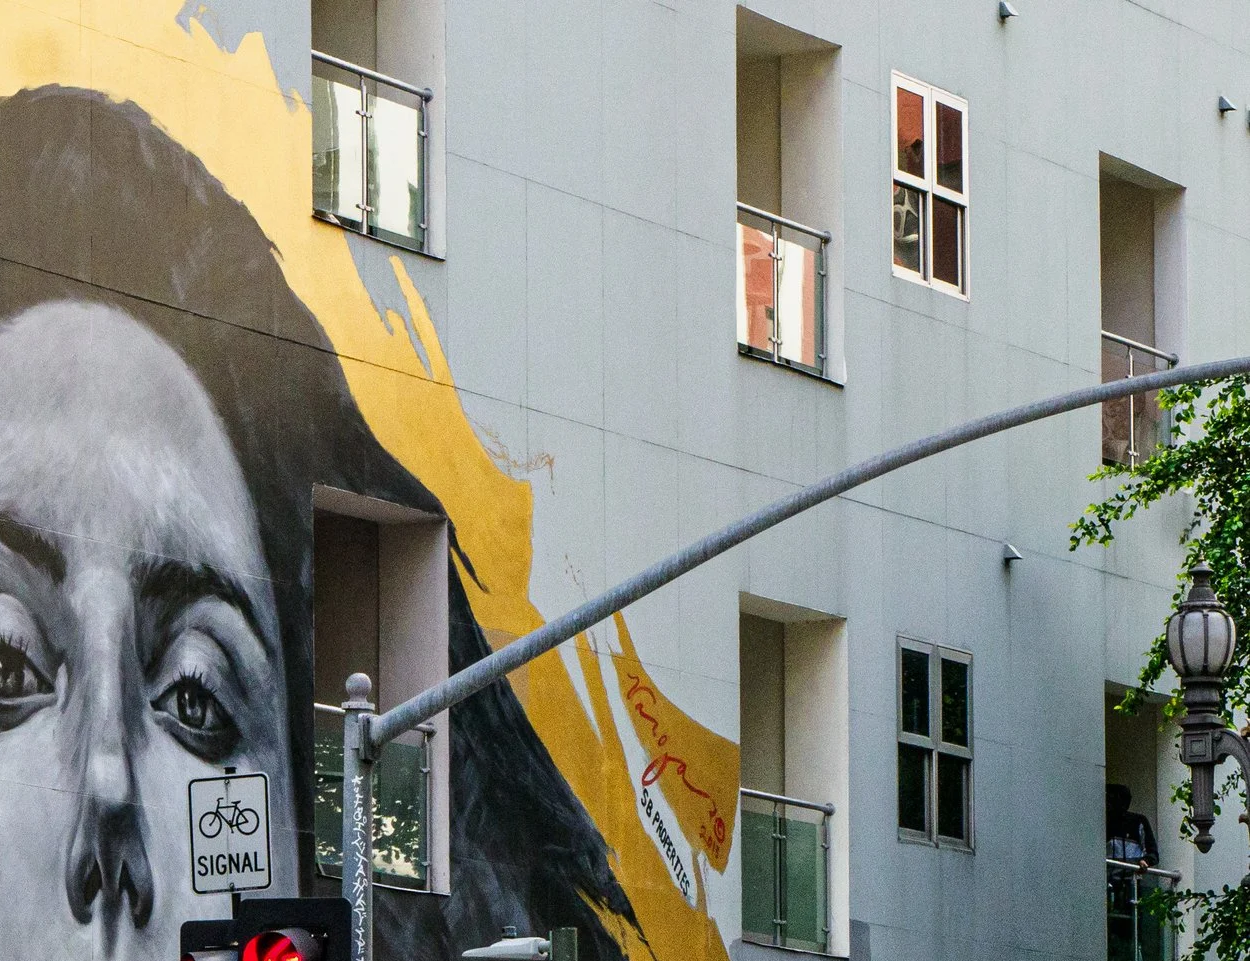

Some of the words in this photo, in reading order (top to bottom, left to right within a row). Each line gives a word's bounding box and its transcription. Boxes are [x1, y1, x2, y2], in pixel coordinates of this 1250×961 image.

[197, 851, 265, 877] SIGNAL
[640, 788, 654, 818] SB
[652, 811, 690, 896] PROPERTIES
